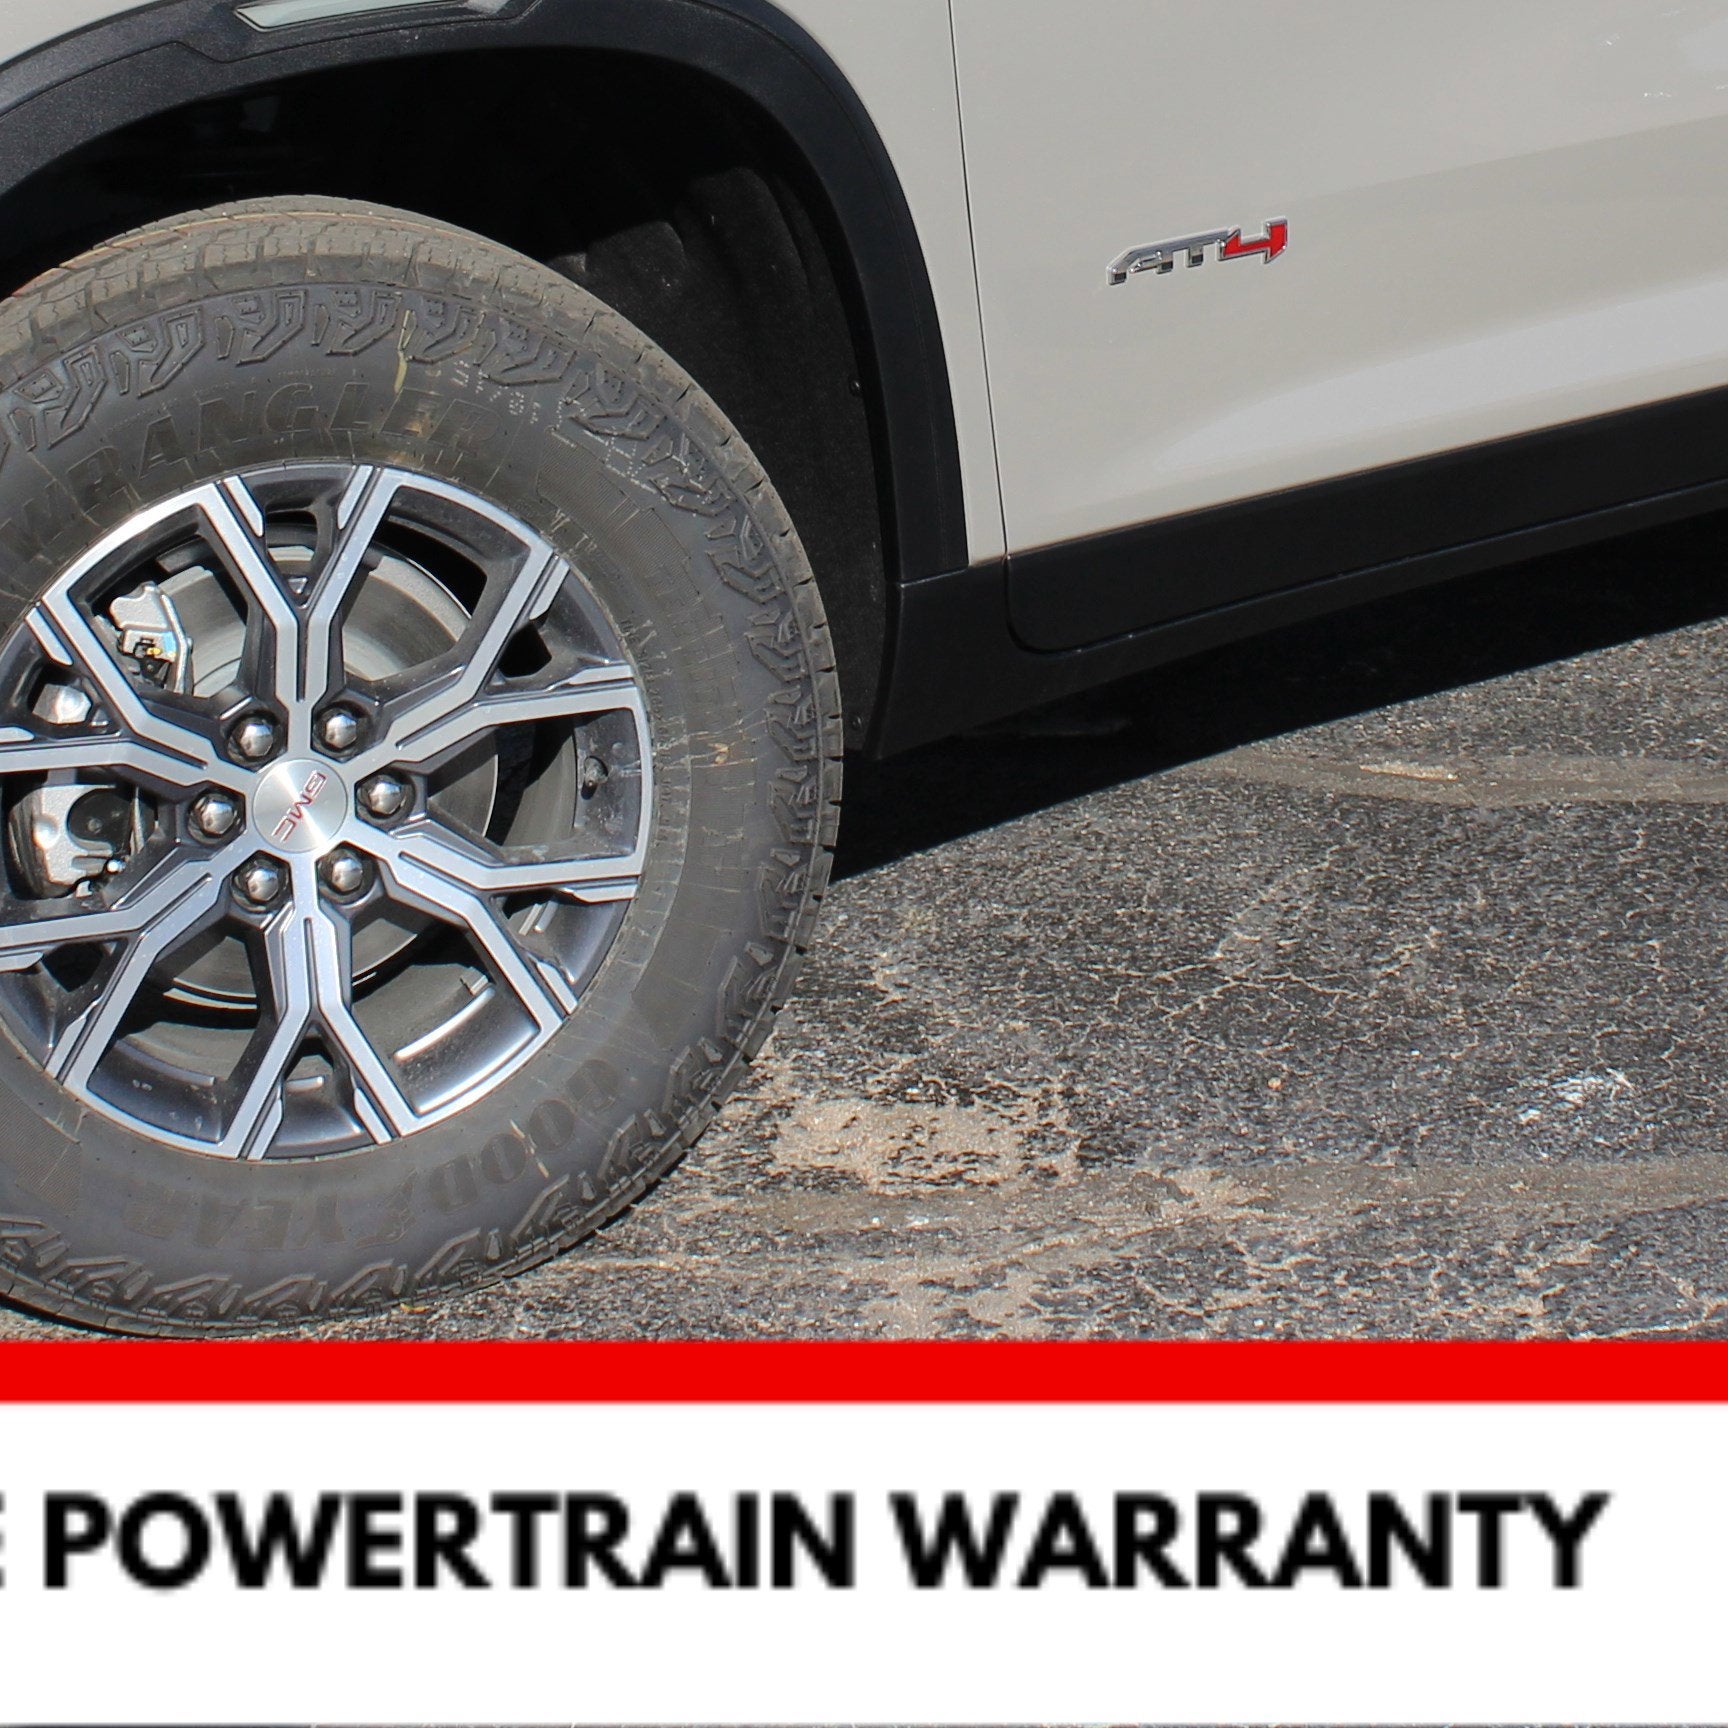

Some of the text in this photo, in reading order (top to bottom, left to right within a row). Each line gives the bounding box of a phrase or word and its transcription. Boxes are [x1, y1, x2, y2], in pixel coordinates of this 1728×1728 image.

[1106, 215, 1288, 286] AT4
[271, 770, 328, 844] GMC
[120, 1058, 620, 1251] GOODYEAR
